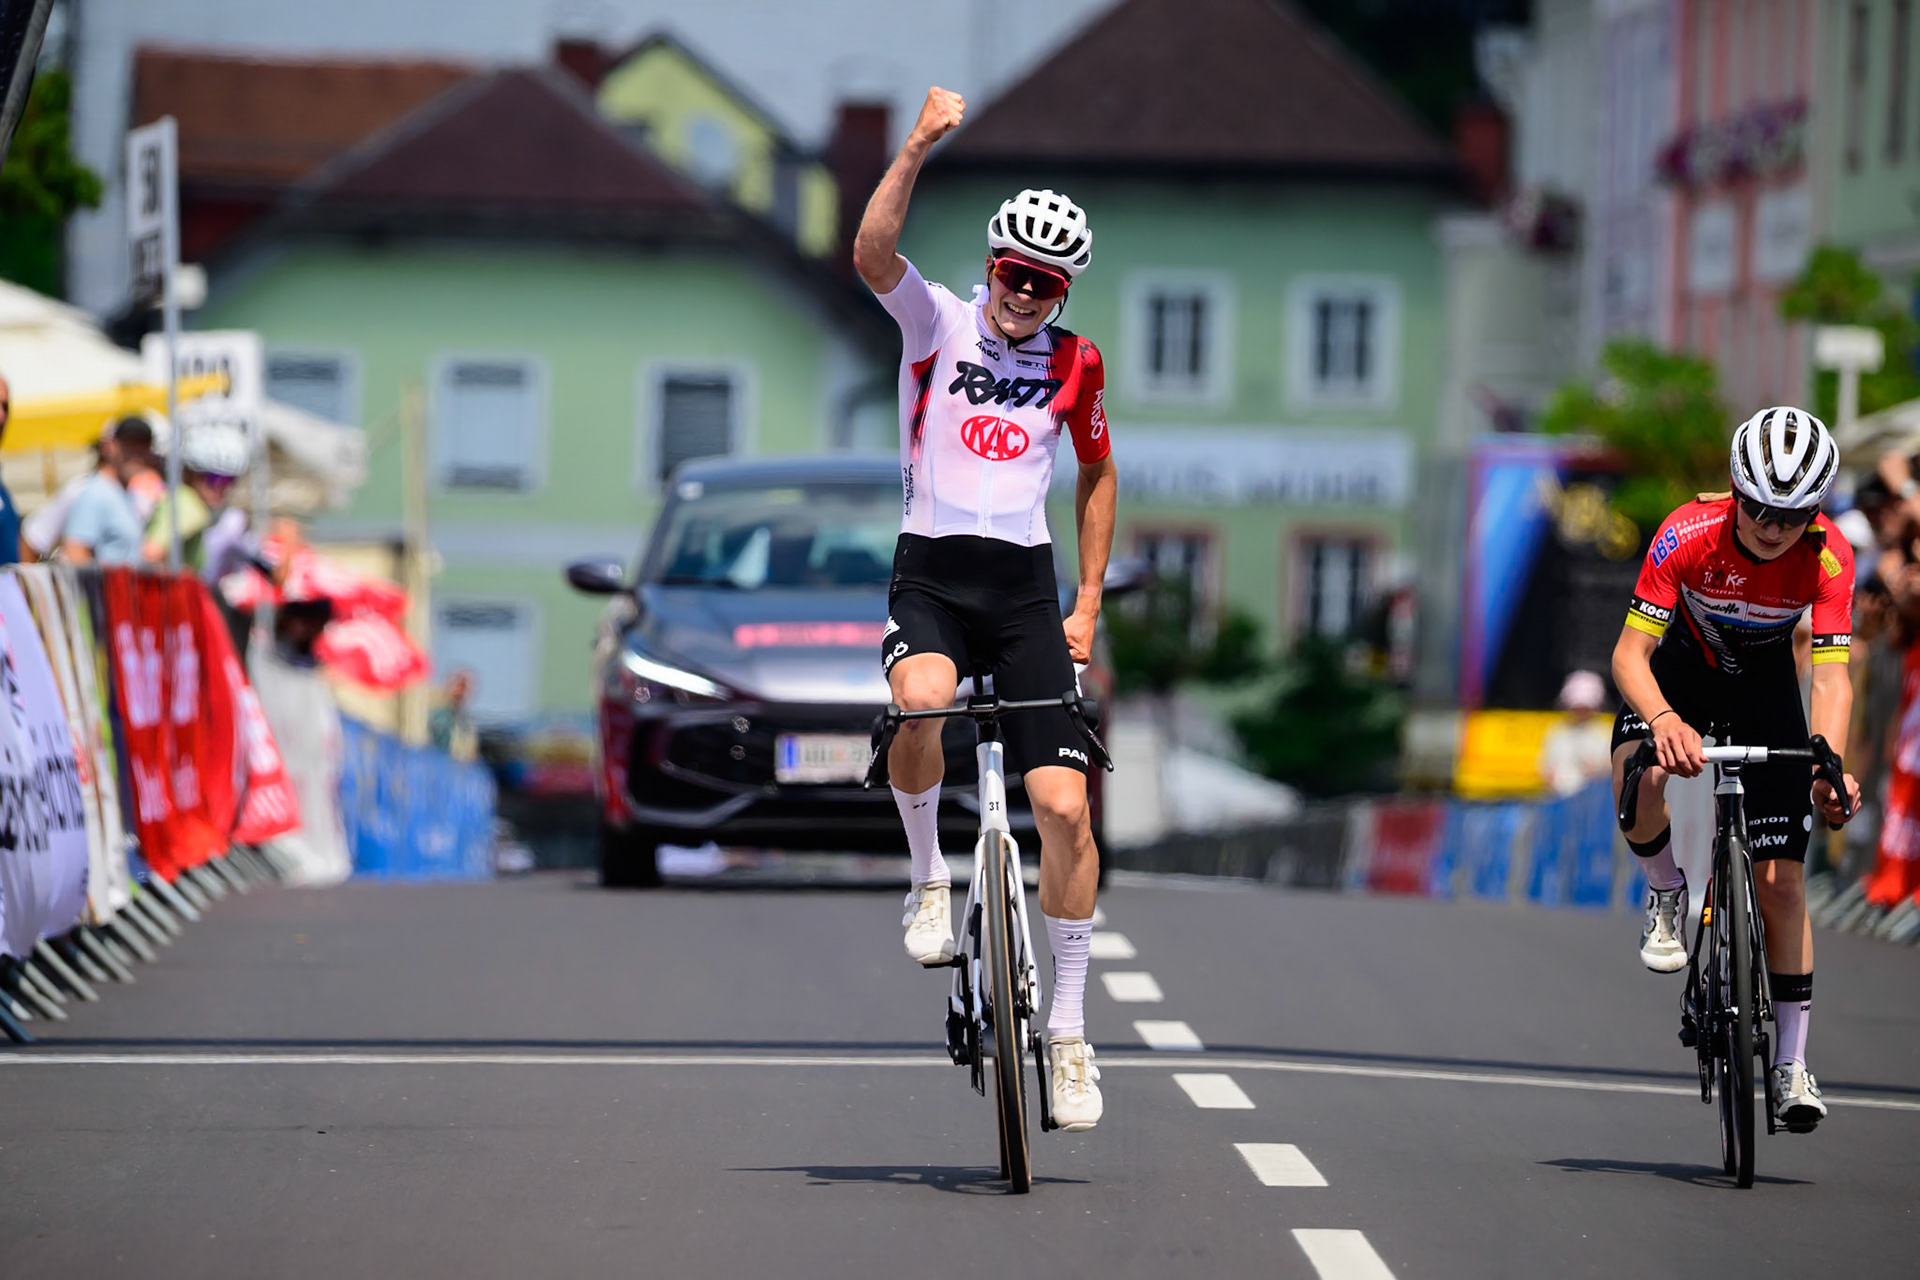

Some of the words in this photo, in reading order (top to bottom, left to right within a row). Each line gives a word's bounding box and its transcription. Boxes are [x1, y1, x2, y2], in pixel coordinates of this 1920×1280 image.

[963, 416, 1027, 460] KAC
[1676, 513, 1708, 529] PAPER
[1678, 513, 1728, 537] PERFORMANCE
[1681, 527, 1709, 544] GROUP
[1639, 601, 1671, 620] KOCH
[883, 641, 909, 675] BÖ
[988, 802, 1000, 811] 3T
